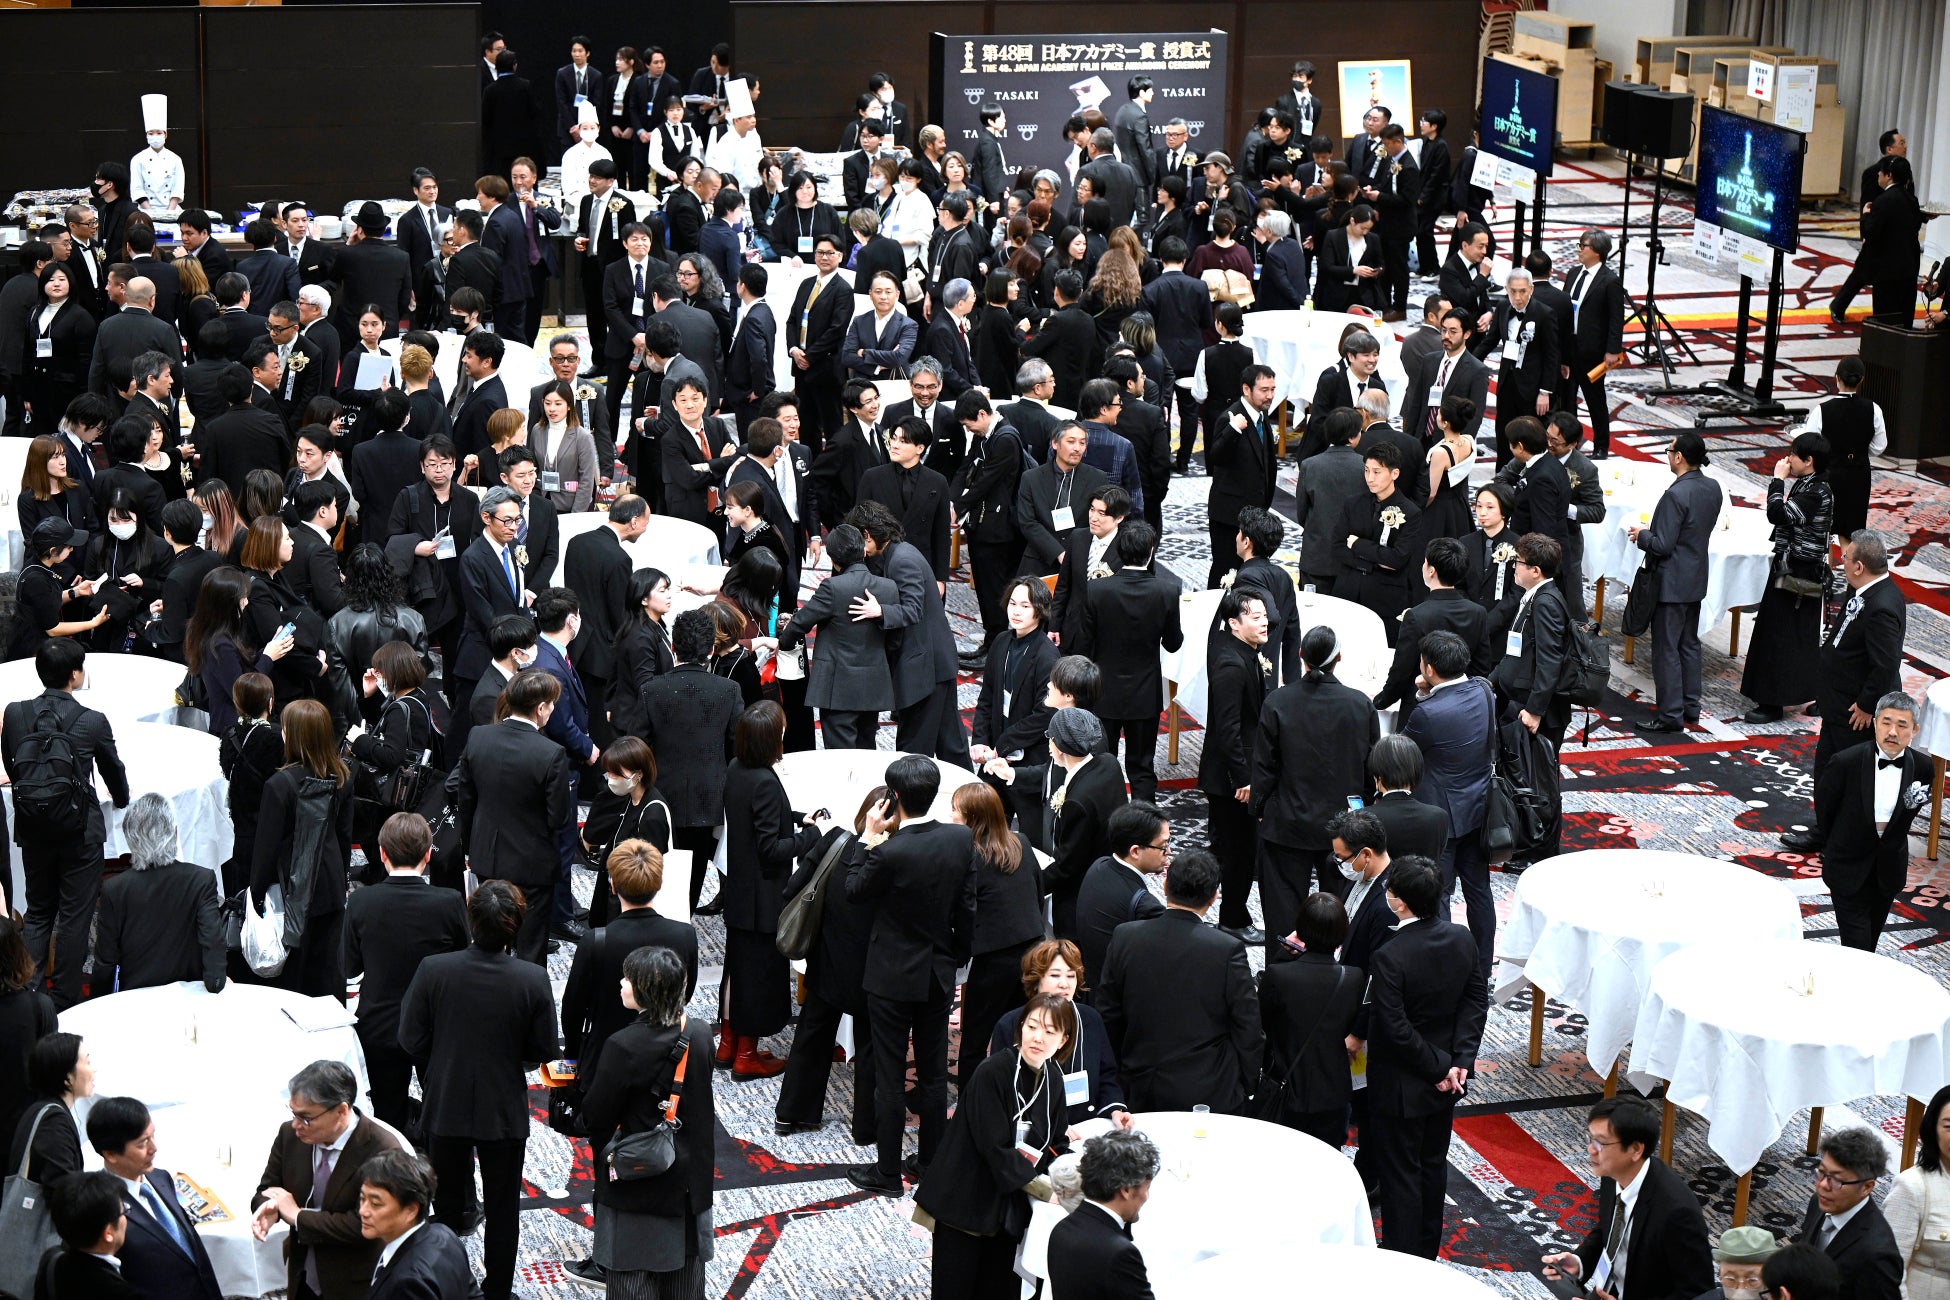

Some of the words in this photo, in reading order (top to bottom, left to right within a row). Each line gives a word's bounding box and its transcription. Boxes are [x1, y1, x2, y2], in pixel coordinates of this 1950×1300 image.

[982, 44, 1033, 62] 第48回
[1042, 42, 1157, 61] 日本アカデミー賞
[1162, 41, 1211, 60] 授賞式
[1013, 63, 1040, 73] JAPAN
[1040, 63, 1079, 72] ACADEMY
[994, 91, 1039, 100] TASAKI
[1162, 88, 1205, 97] TASAKI
[963, 129, 1007, 138] TAKI
[1494, 116, 1537, 144] 日本アカデミー賞
[1716, 176, 1775, 214] 日本アカデミー賞
